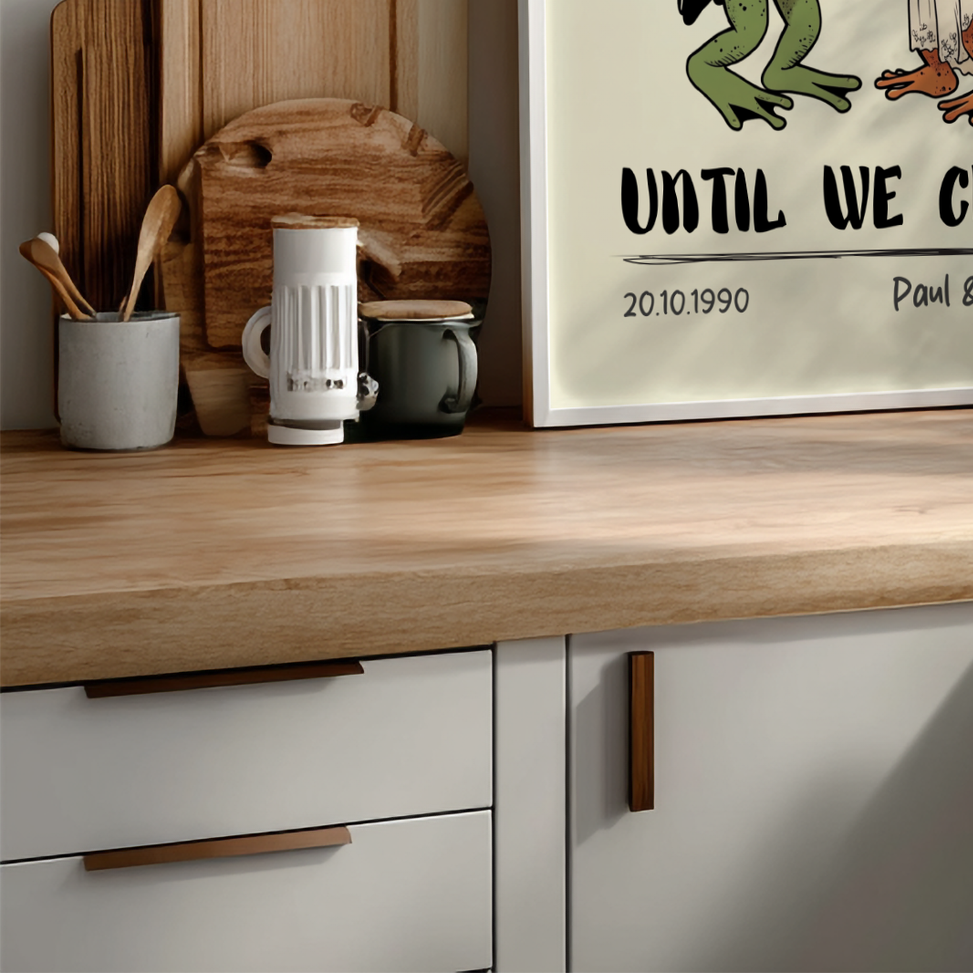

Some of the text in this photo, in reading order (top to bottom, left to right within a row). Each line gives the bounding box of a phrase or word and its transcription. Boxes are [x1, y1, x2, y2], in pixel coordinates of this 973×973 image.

[620, 167, 787, 235] UNTIL
[822, 163, 904, 231] WE
[623, 287, 750, 318] 20.10.1990
[892, 273, 951, 312] Paul
